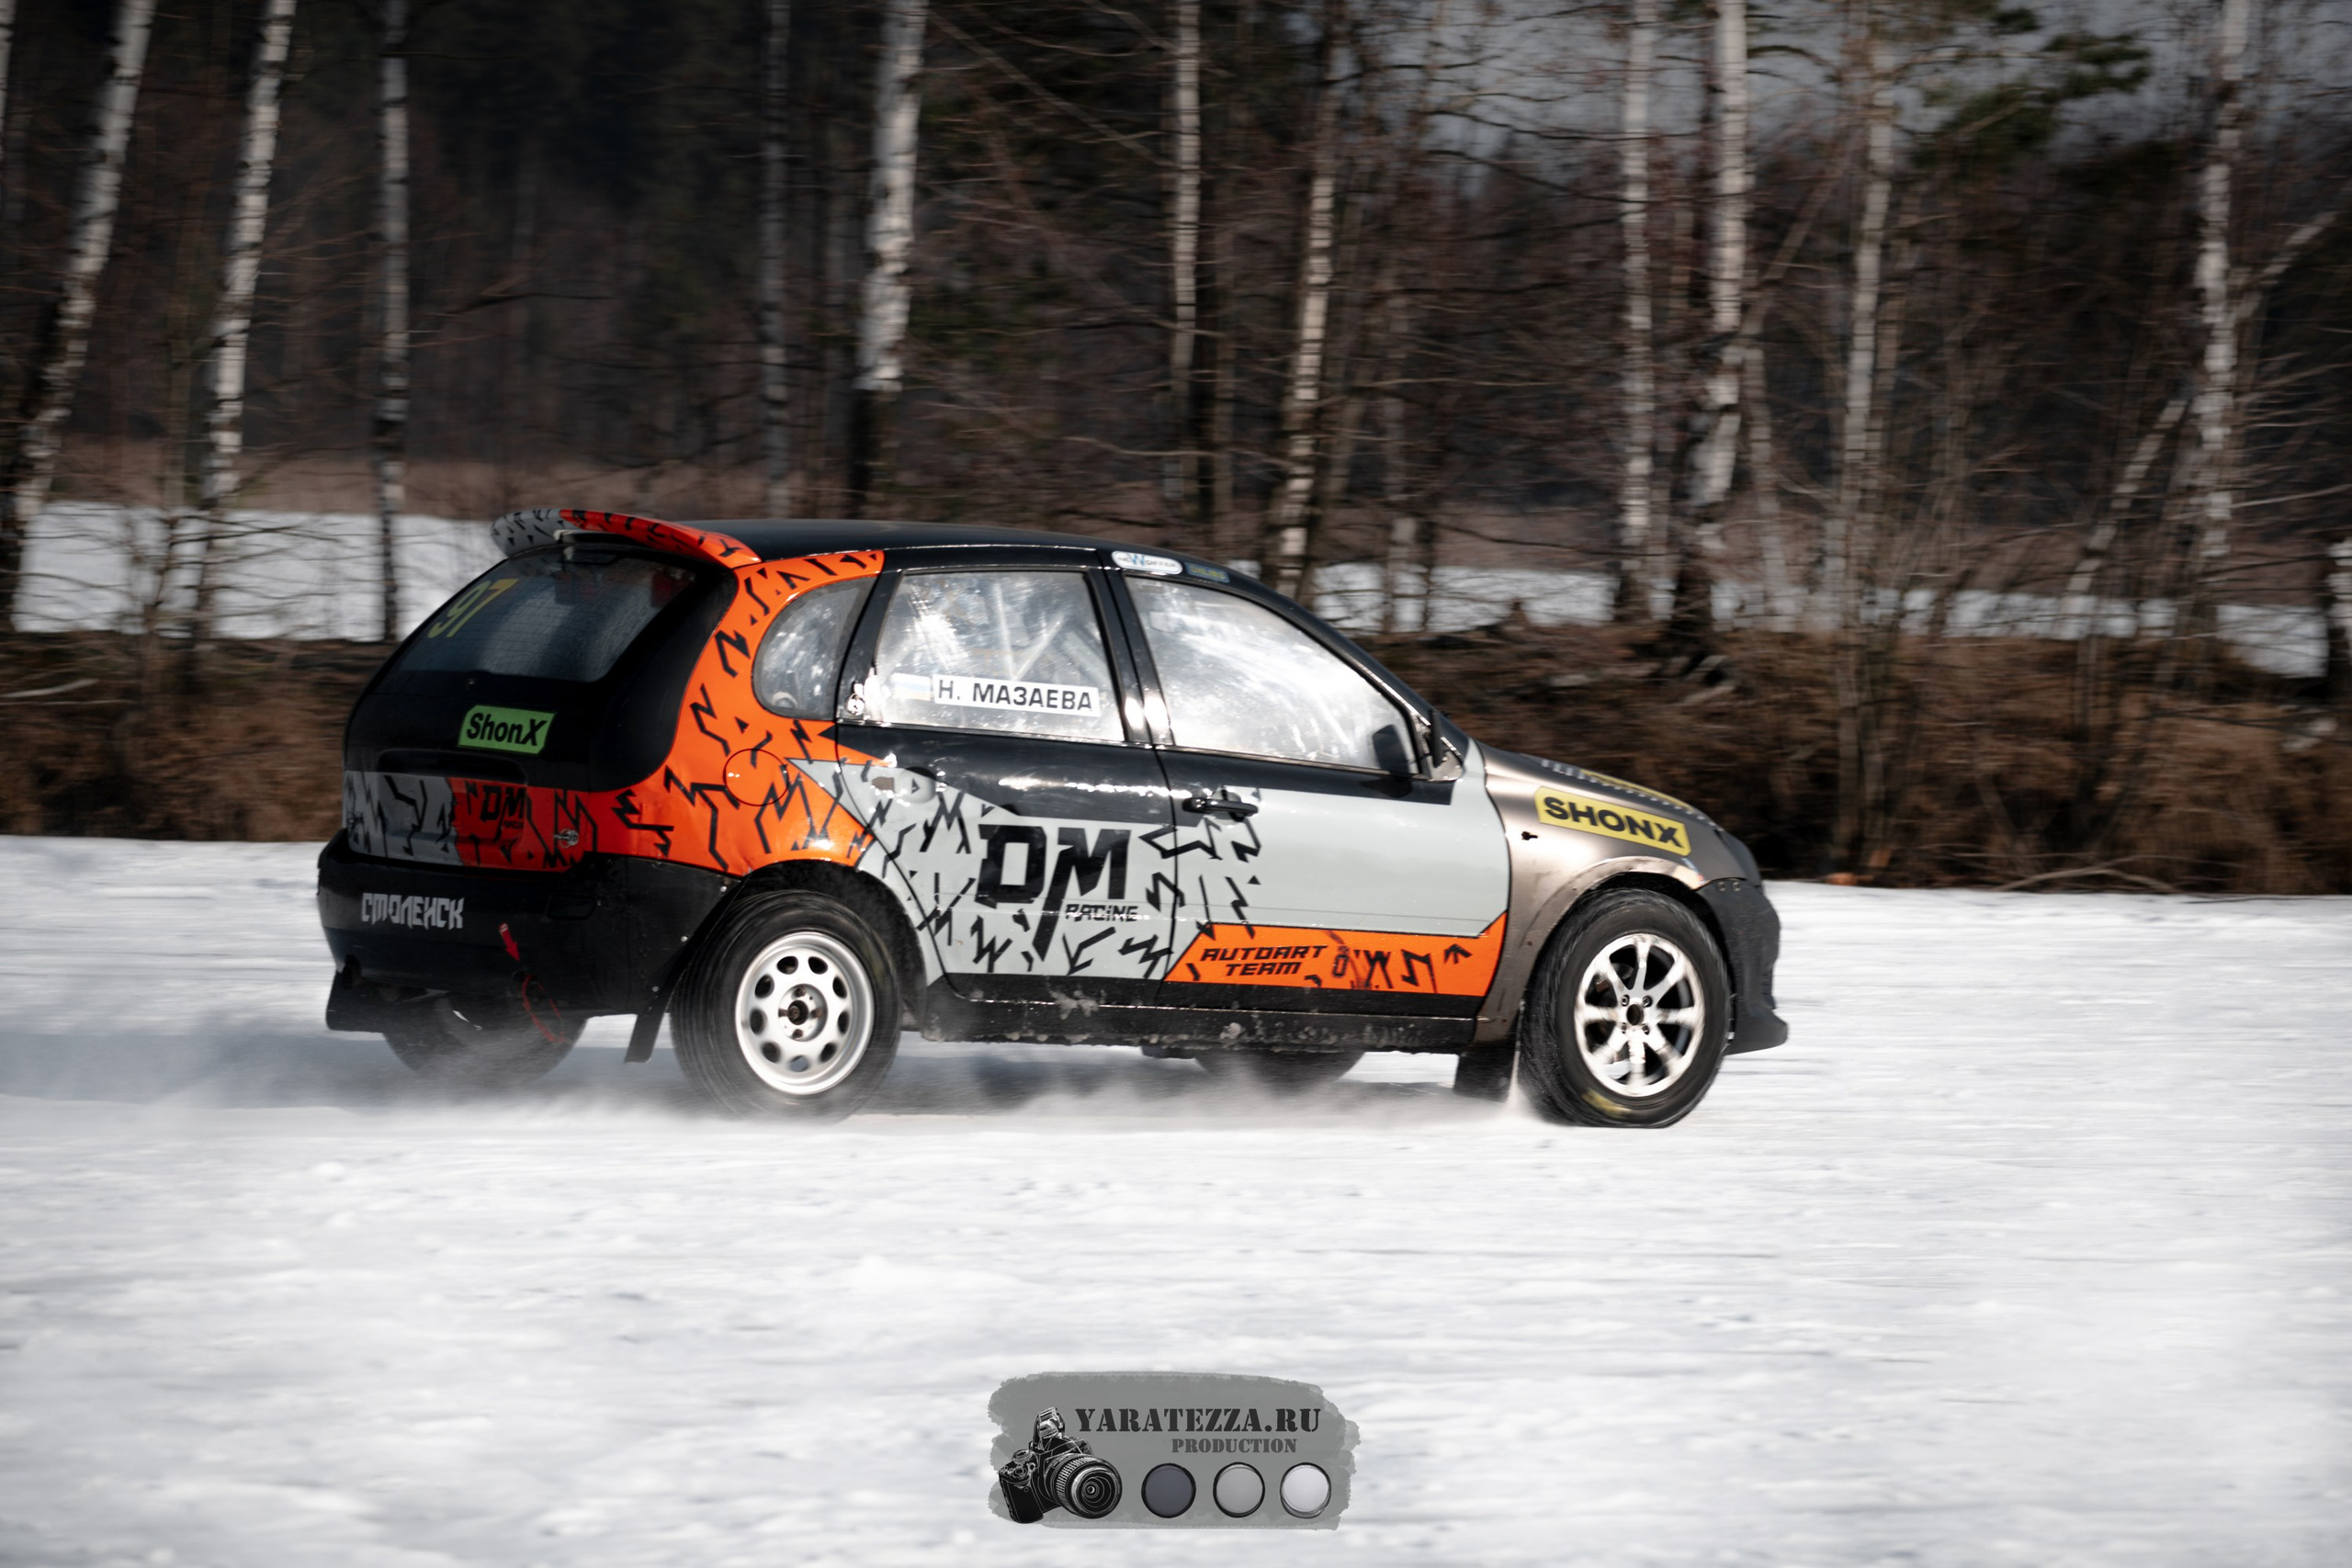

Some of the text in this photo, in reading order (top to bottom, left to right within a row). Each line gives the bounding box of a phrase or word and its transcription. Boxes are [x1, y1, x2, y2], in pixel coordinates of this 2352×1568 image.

[427, 579, 519, 638] 97
[938, 680, 1092, 711] Н. МАЗАЕВА
[467, 713, 548, 746] ShonX
[1544, 796, 1682, 848] SHONX
[974, 823, 1132, 962] DM
[1200, 945, 1329, 962] AUTOART
[1226, 962, 1302, 976] TEAM
